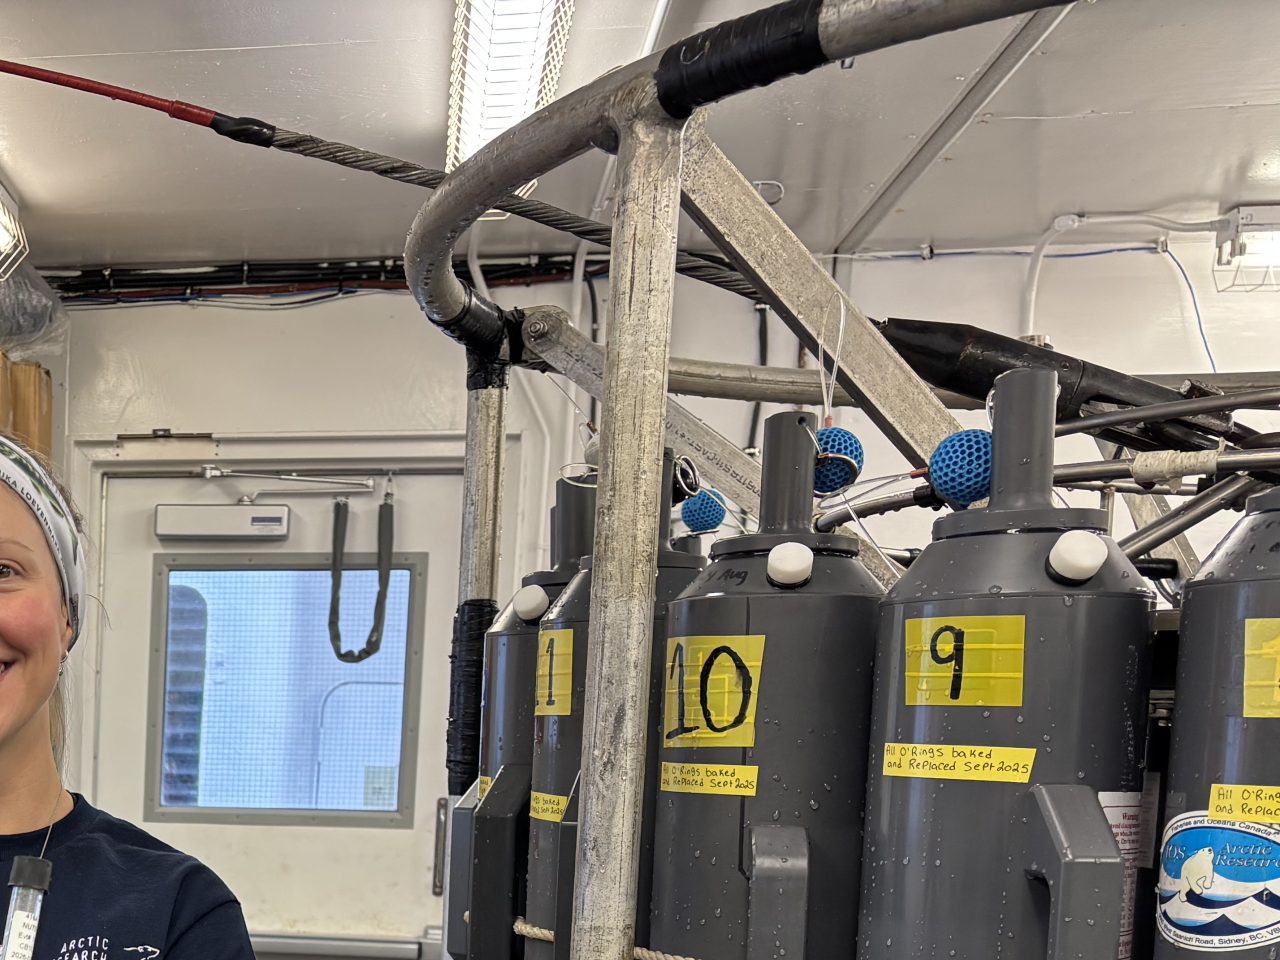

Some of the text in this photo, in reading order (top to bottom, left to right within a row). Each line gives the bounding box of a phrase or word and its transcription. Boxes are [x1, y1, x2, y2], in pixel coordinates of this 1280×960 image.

[718, 568, 748, 586] Aug
[930, 625, 964, 700] 9
[666, 642, 752, 739] 10
[886, 744, 896, 755] All
[952, 747, 993, 759] baked
[706, 768, 737, 777] baked
[888, 758, 903, 769] and
[996, 761, 1030, 774] 2025
[734, 778, 755, 790] 2025
[1218, 787, 1233, 800] All
[1216, 804, 1234, 815] and
[1207, 819, 1236, 827] Oceans
[1238, 822, 1273, 837] Canada
[1222, 842, 1273, 855] Arctic
[61, 936, 109, 954] ARCTIC
[1195, 937, 1216, 946] Road,
[1218, 936, 1249, 945] Sidney,
